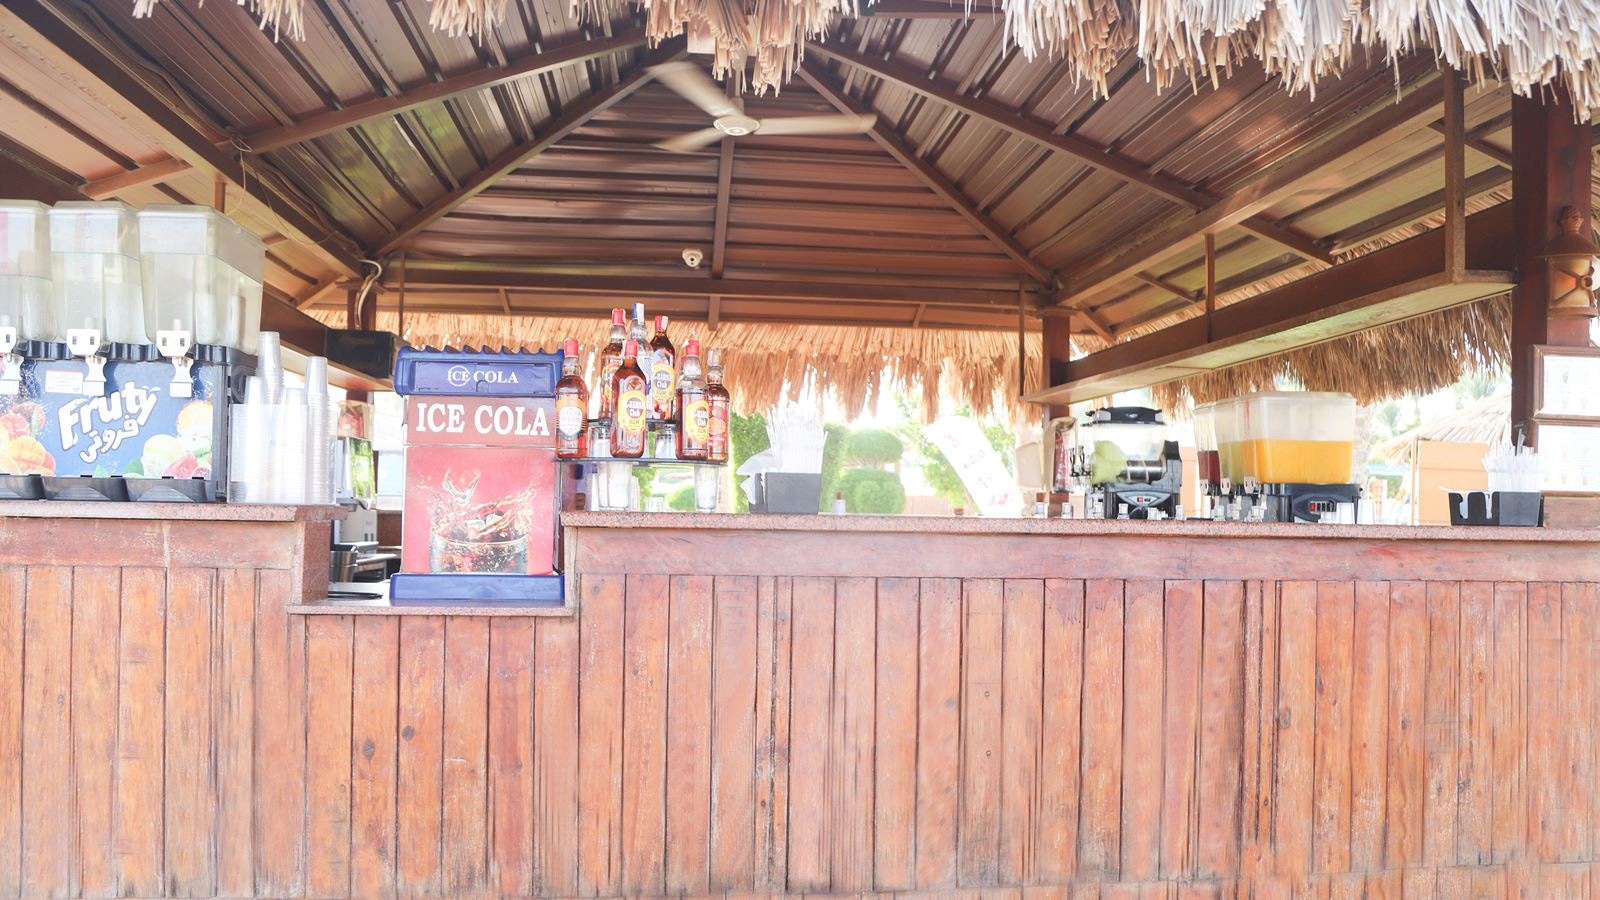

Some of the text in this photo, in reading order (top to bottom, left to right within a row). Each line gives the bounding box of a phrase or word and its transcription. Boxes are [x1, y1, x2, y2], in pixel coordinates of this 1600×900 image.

[447, 370, 519, 384] ICE COLA
[58, 381, 159, 451] Fruty
[416, 403, 550, 437] ICE COLA
